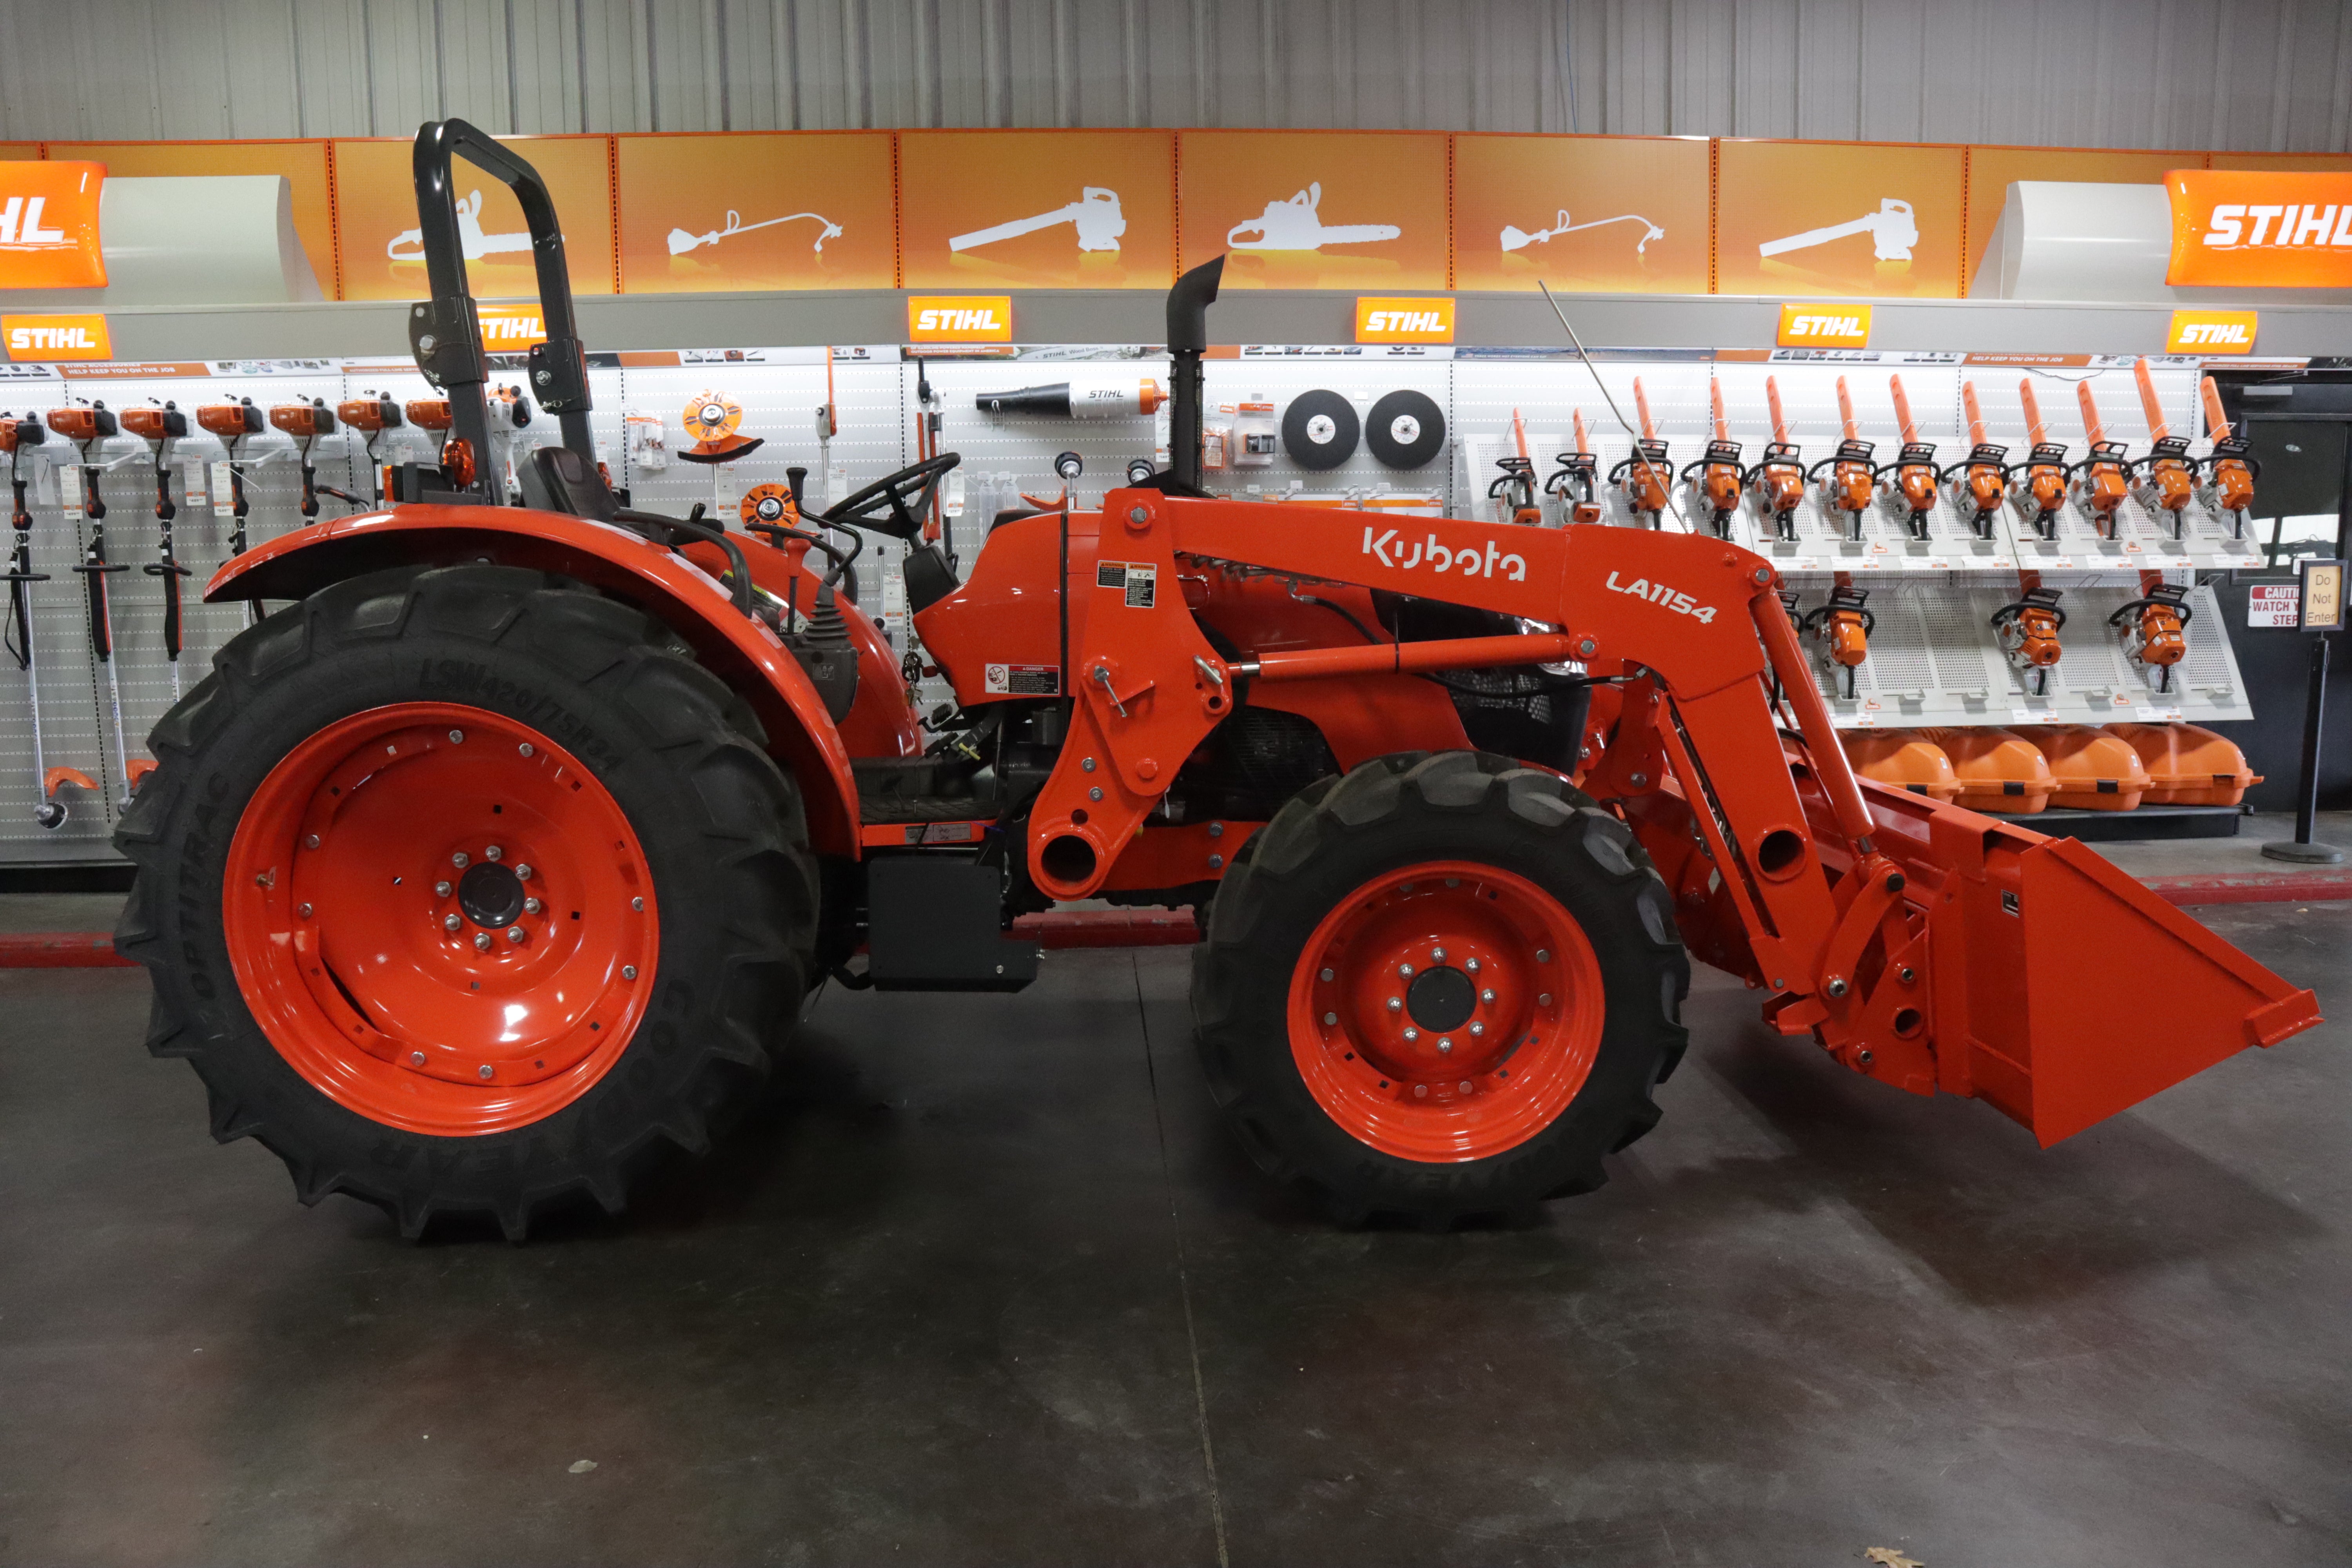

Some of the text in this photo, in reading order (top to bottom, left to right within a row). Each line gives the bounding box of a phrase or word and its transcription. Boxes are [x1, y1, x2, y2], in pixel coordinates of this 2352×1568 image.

[2203, 205, 2352, 245] STIHL
[479, 318, 546, 339] TIHL
[918, 310, 1000, 330] STIHL
[1366, 312, 1446, 331] STIHL
[1789, 316, 1864, 336] STIHL
[11, 328, 95, 348] STIHL
[2179, 324, 2249, 343] STIHL
[1089, 390, 1124, 398] STIHL
[1362, 526, 1526, 581] Kubota
[2316, 575, 2330, 585] Do
[1606, 571, 1717, 624] LA1154
[2265, 587, 2299, 599] CAUTI
[2313, 593, 2331, 604] Not
[2253, 601, 2289, 612] WATCH
[2307, 612, 2335, 623] Enter
